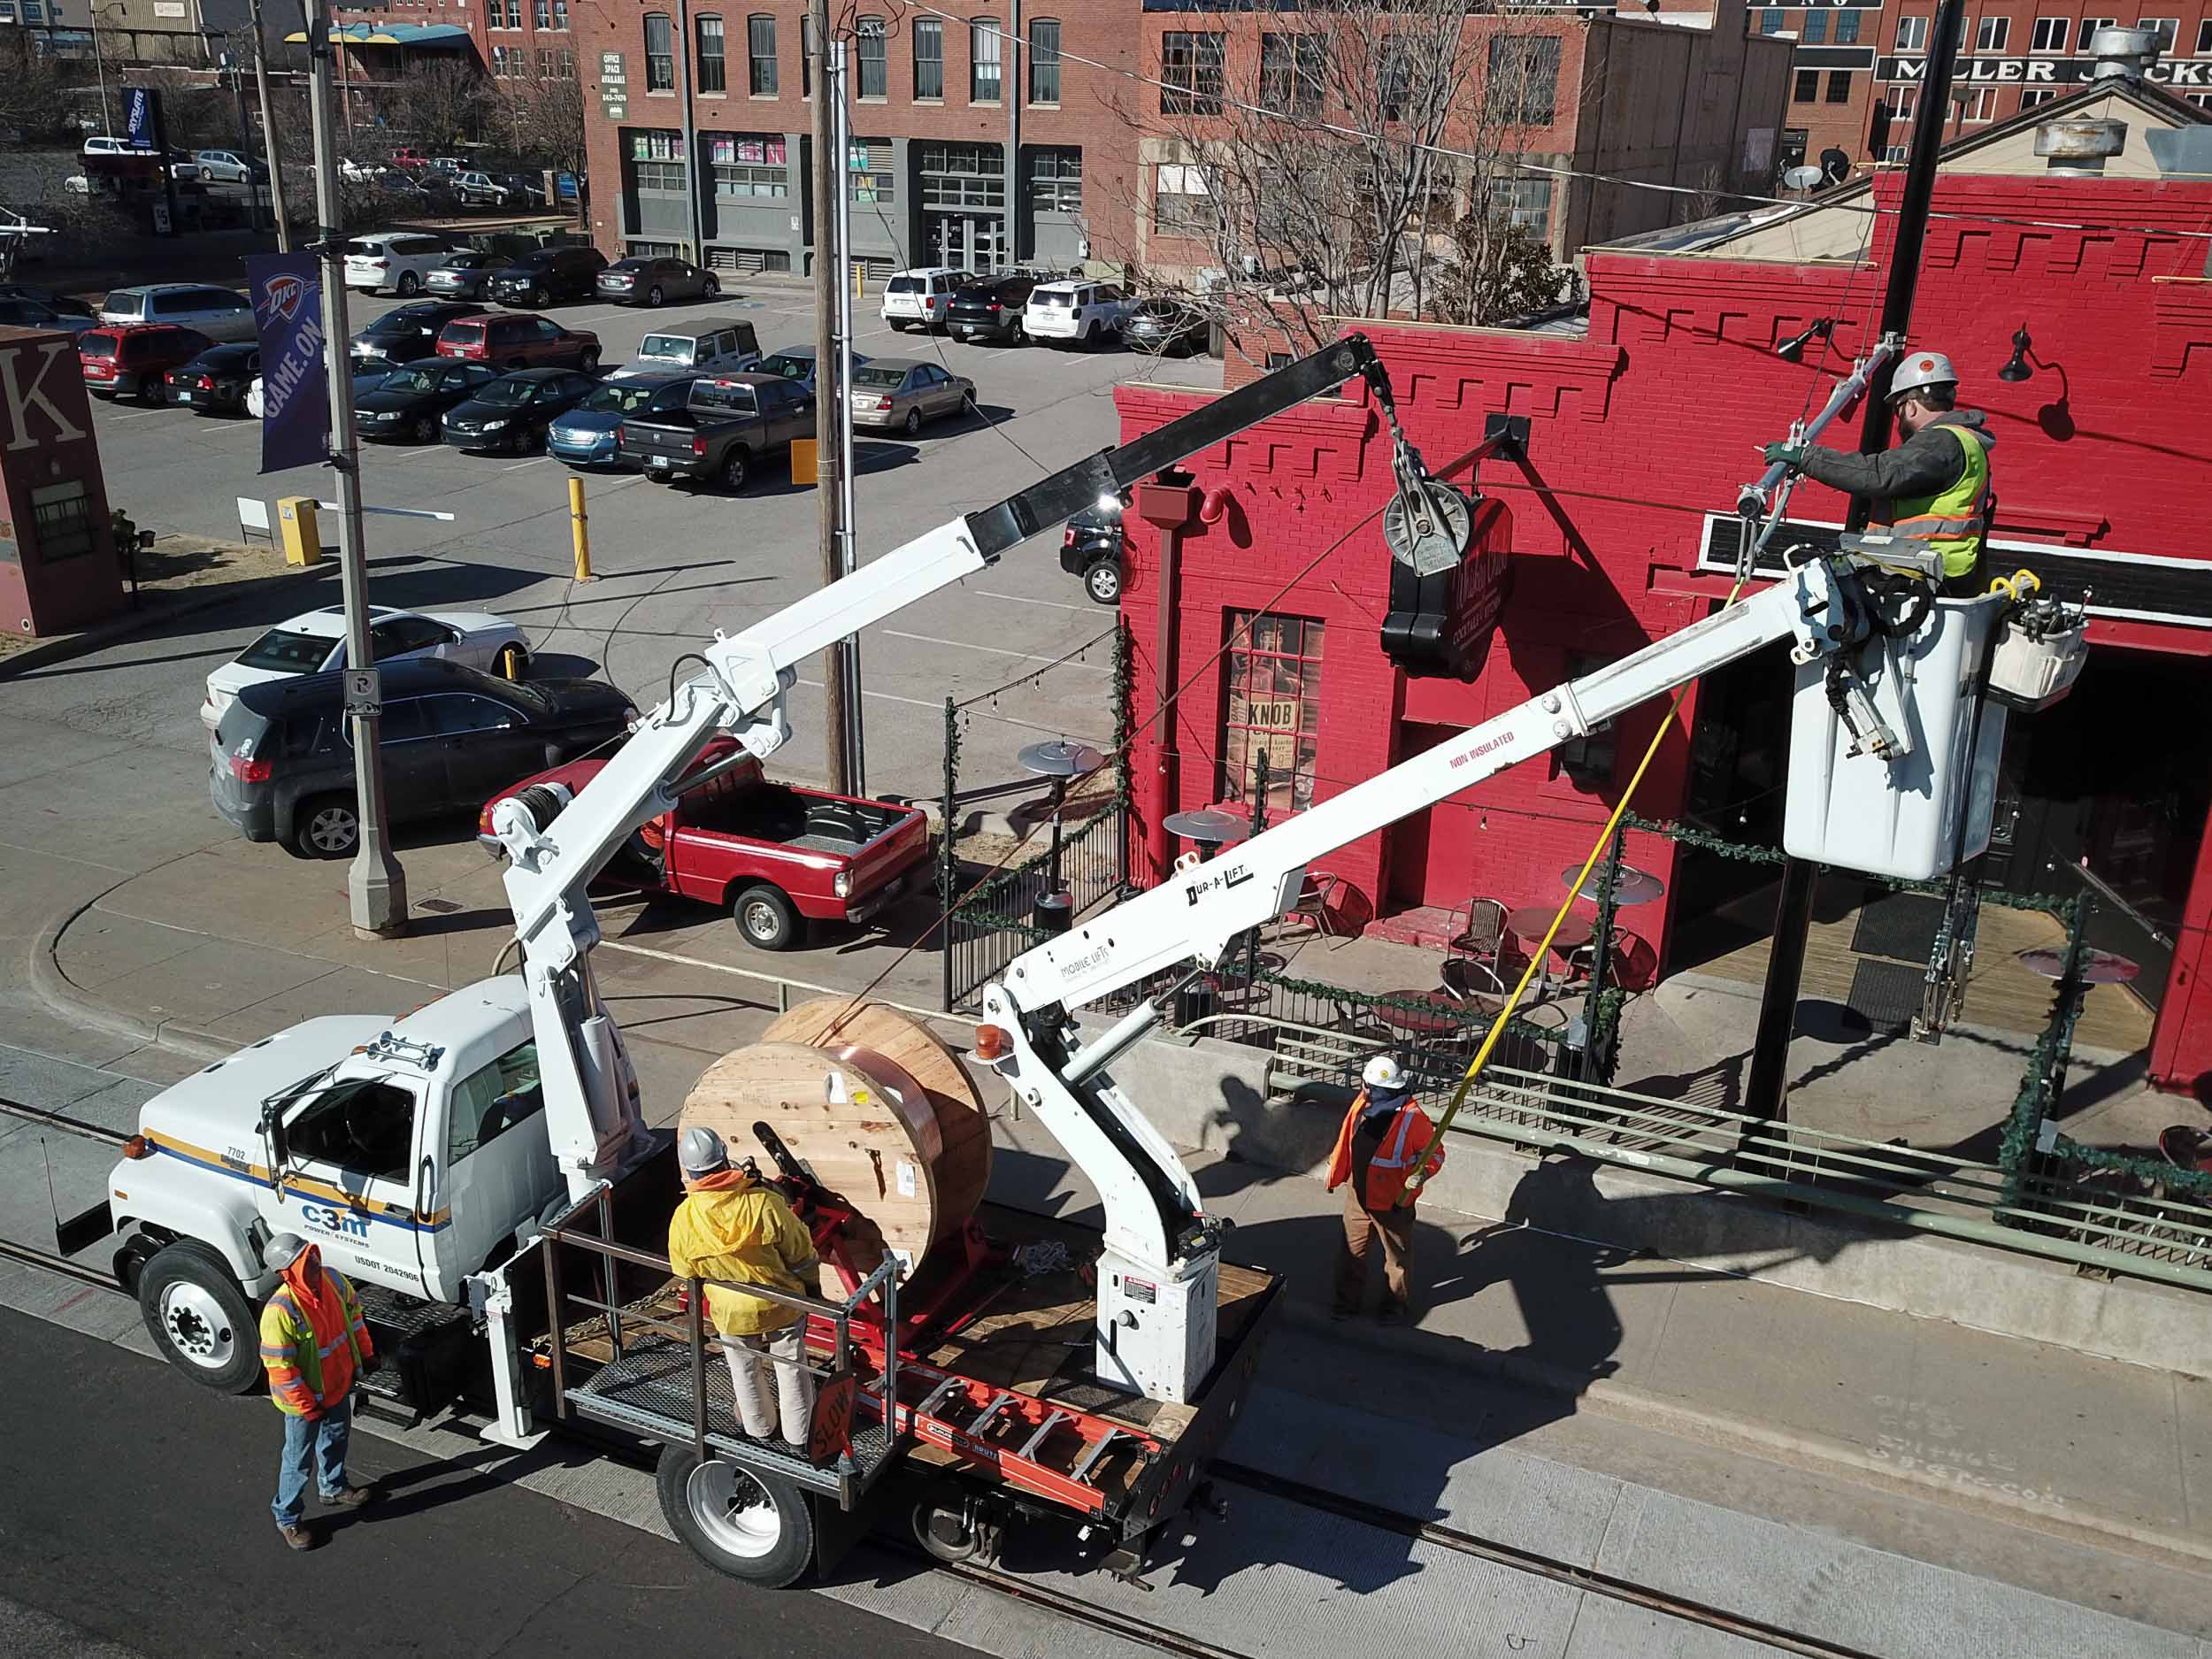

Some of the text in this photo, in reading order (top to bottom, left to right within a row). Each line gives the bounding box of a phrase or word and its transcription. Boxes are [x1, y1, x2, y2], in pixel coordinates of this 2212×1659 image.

[604, 65, 620, 73] SPACE
[1248, 703, 1292, 726] KNOB
[1449, 731, 1515, 769] NON INSULATED
[1061, 956, 1091, 977] MOBILE
[227, 1146, 246, 1160] 7702
[303, 1225, 370, 1248] POWER SYSTEMS
[354, 1255, 419, 1282] USDOT 2042906
[815, 1386, 848, 1448] SLOW
